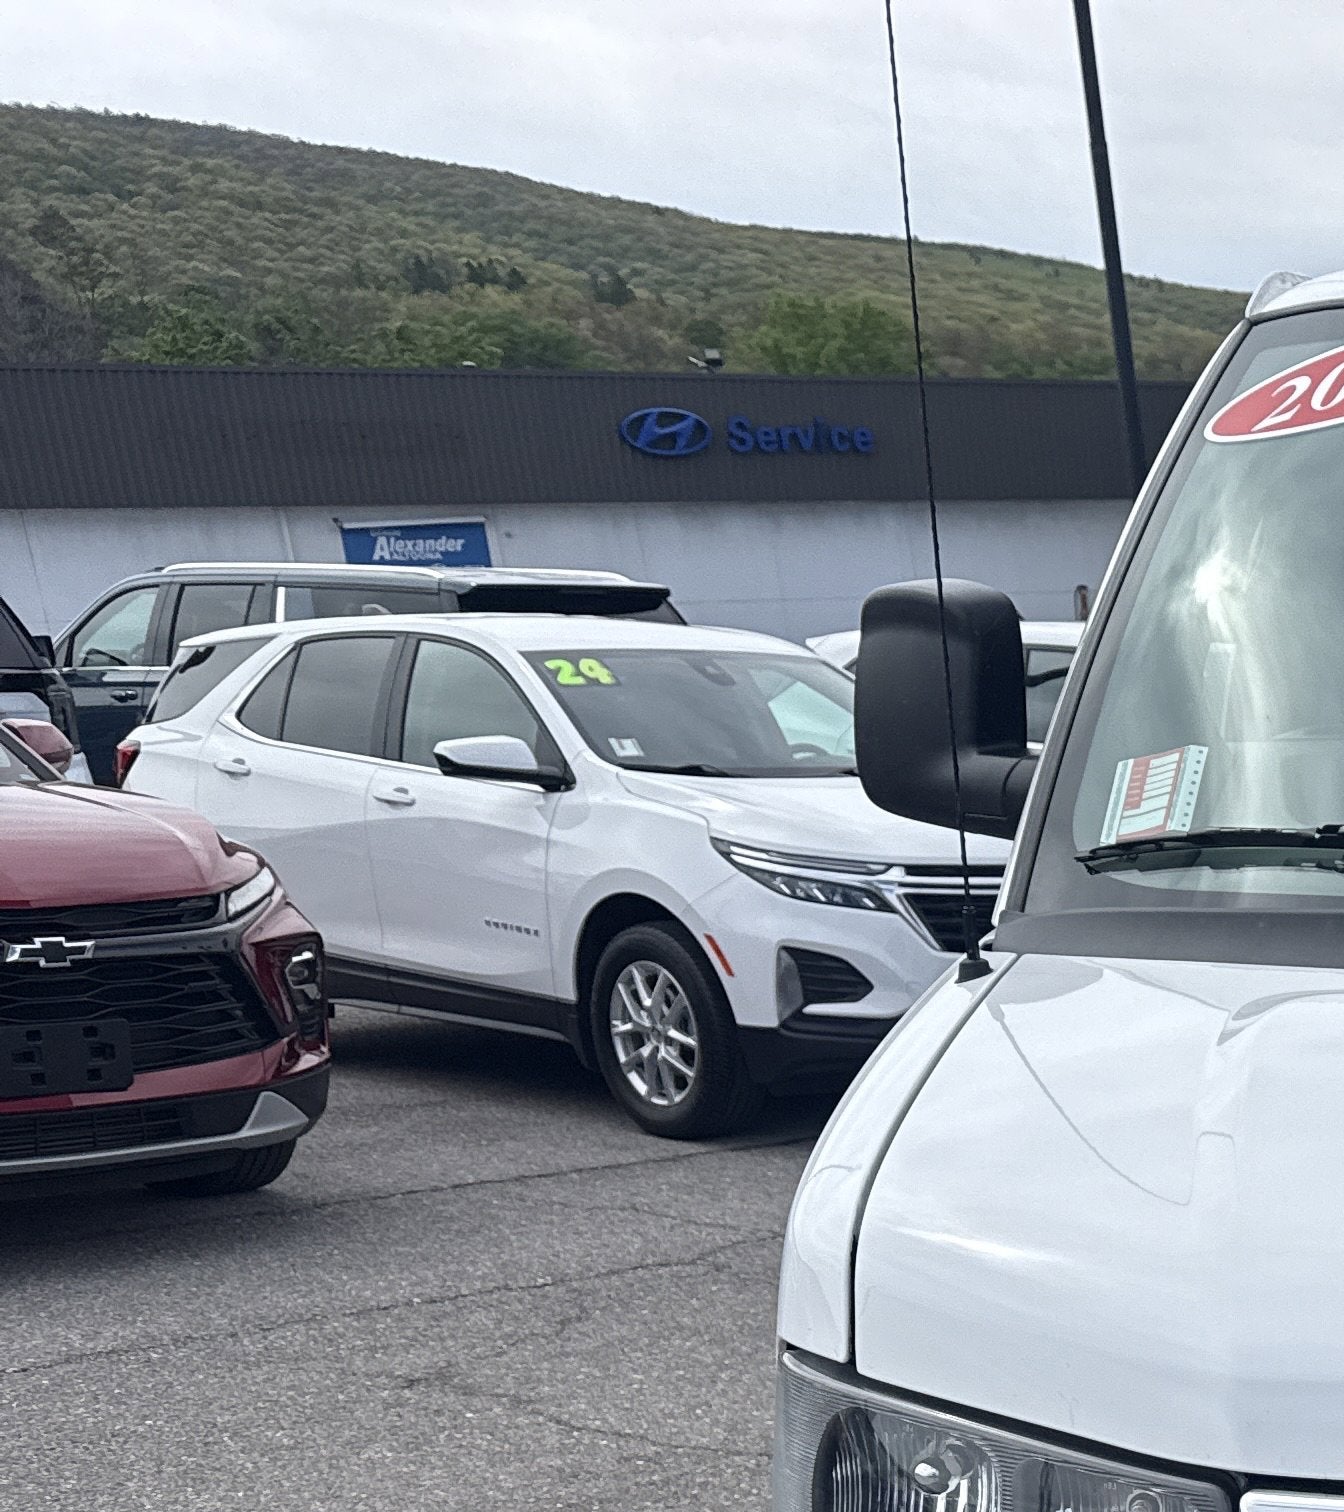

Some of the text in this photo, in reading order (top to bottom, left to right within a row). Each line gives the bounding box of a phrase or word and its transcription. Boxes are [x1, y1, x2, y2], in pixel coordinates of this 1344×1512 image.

[727, 415, 874, 452] Service
[372, 535, 465, 561] Alexander
[543, 658, 616, 685] 24
